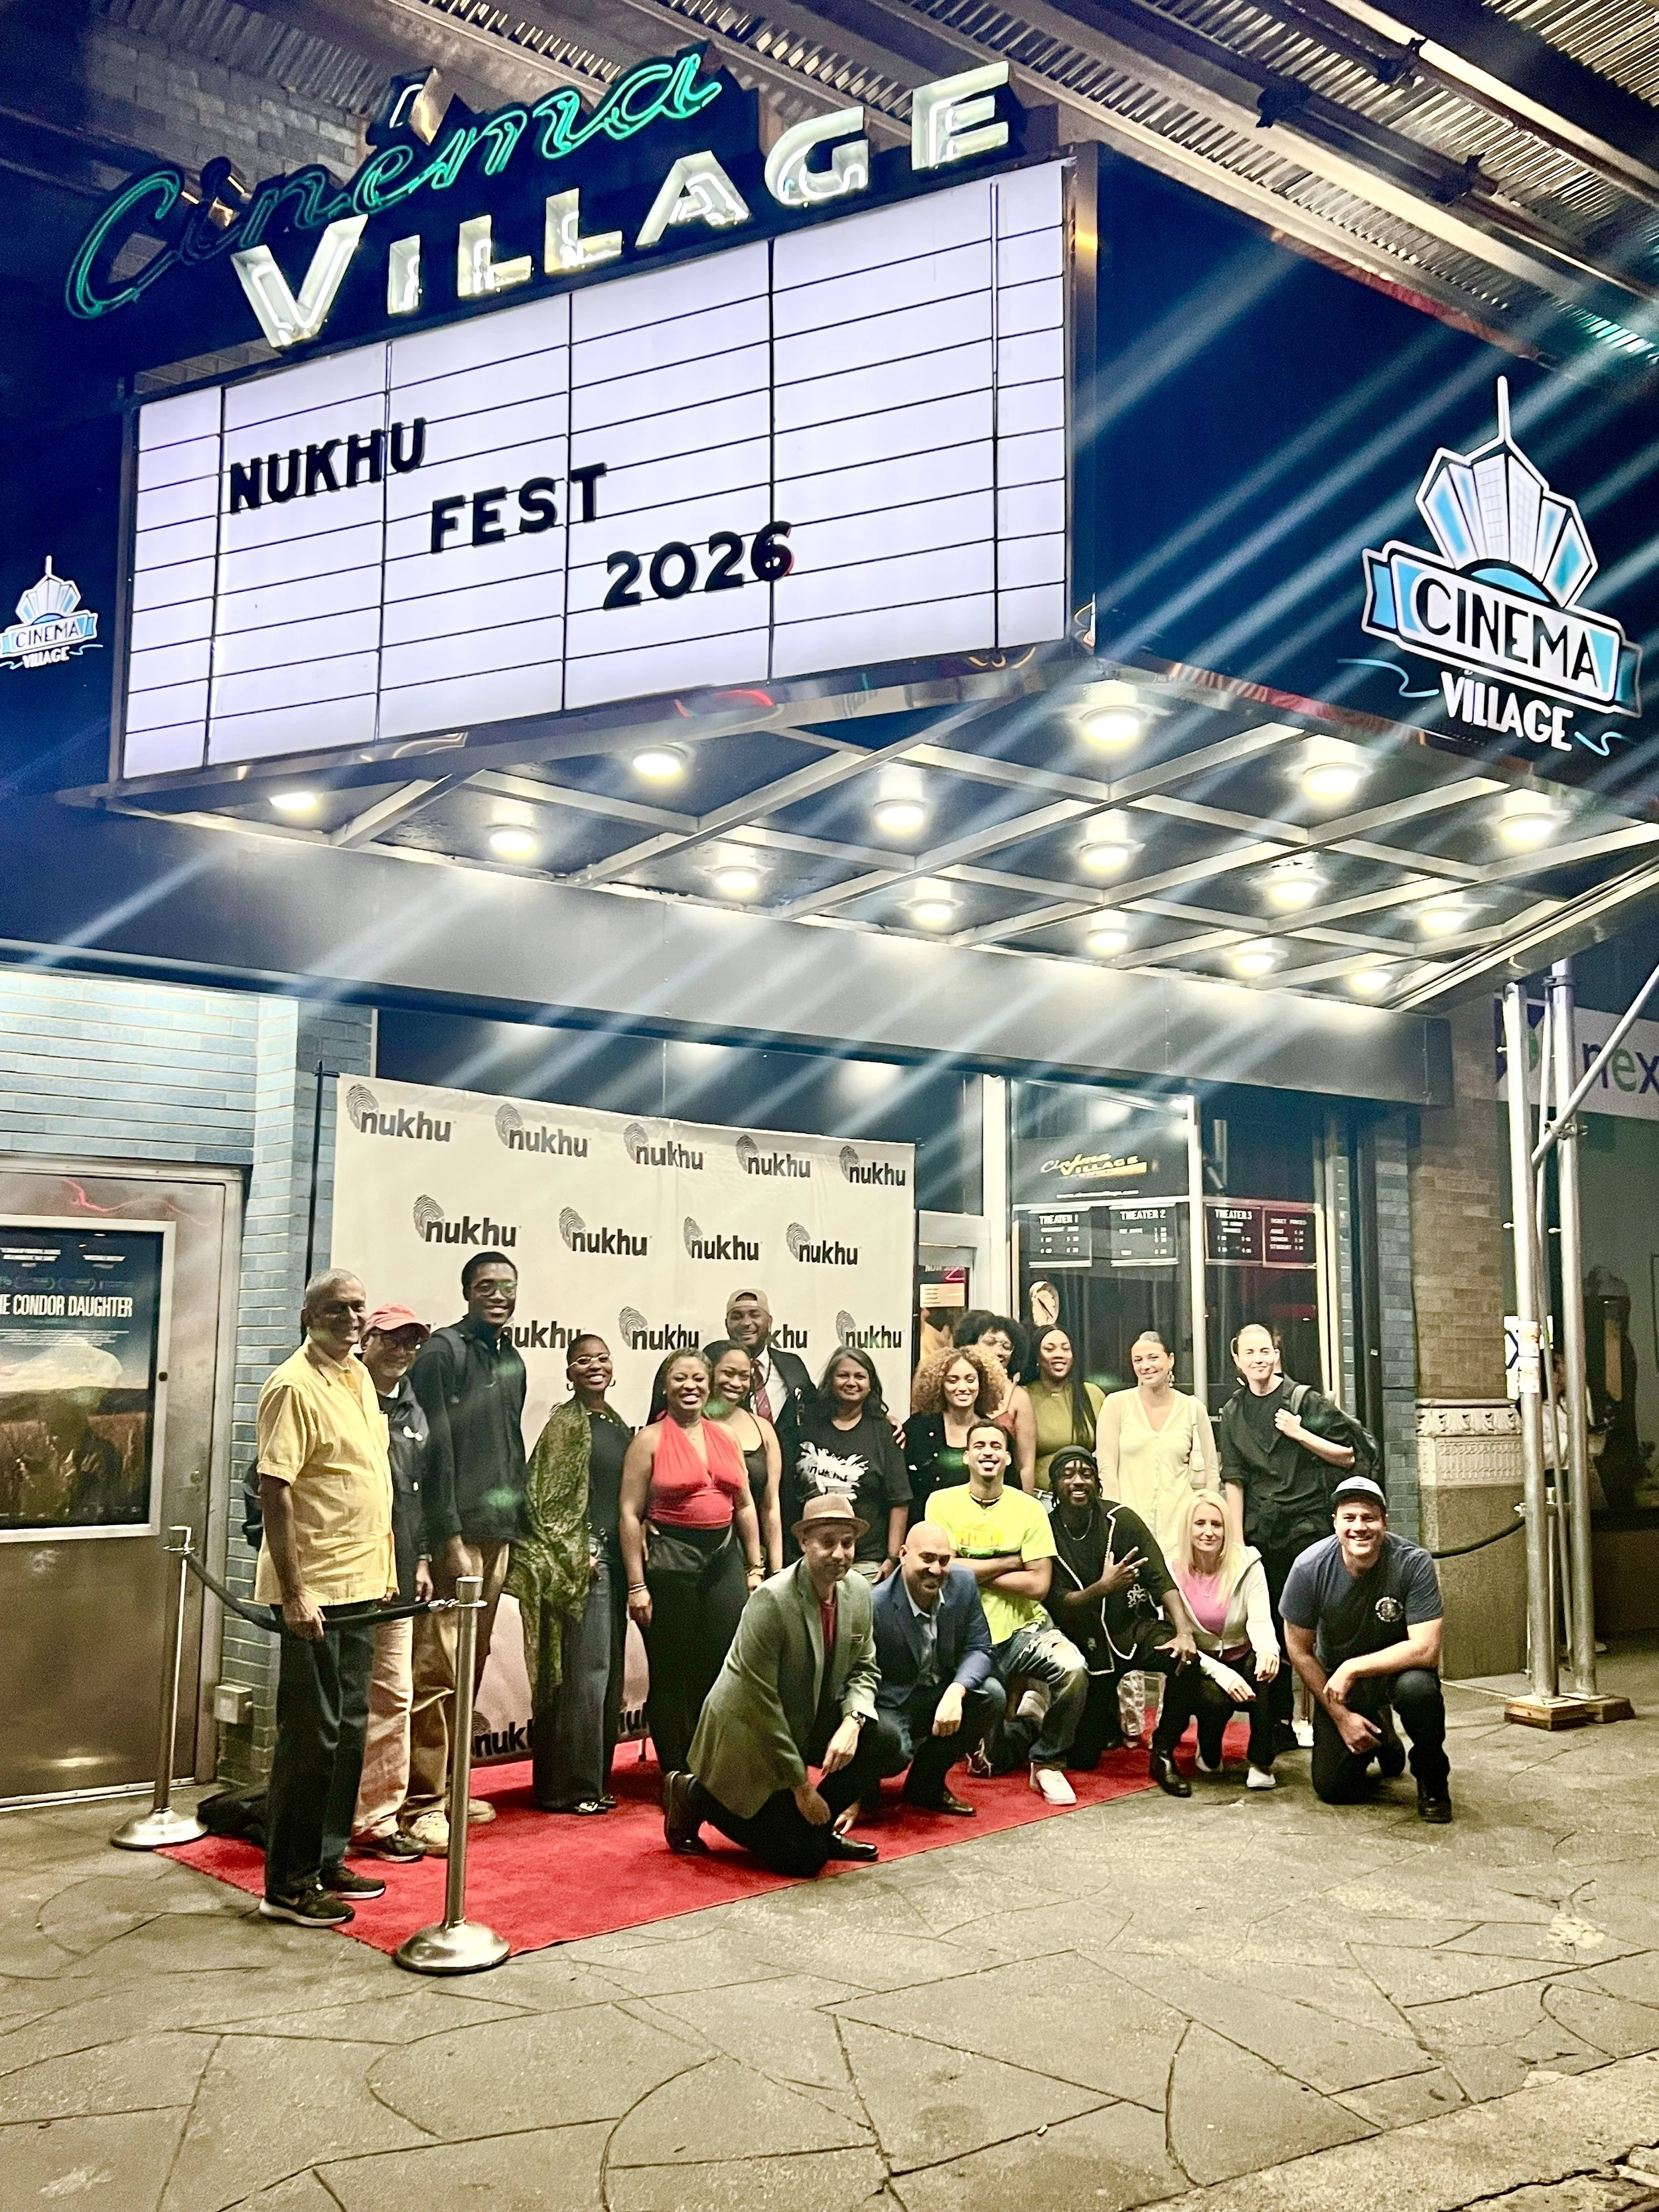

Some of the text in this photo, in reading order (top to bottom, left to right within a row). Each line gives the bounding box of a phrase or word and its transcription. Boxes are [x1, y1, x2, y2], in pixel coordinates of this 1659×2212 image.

[231, 60, 1009, 348] VILLAGE
[230, 417, 426, 514] NUKHU
[430, 462, 607, 553] FEST
[602, 520, 794, 610] 2026
[16, 619, 80, 648] CINEMA
[1415, 577, 1599, 688] CINEMA
[22, 646, 70, 668] VILLAGE
[1441, 670, 1574, 751] VILLAGE
[360, 1109, 452, 1142] nukhu
[509, 1127, 588, 1157] nukhu
[636, 1141, 703, 1170] nukhu
[748, 1153, 811, 1178] nukhu
[1060, 1155, 1139, 1176] VILLAGE
[849, 1162, 906, 1186] nukhu
[1039, 1214, 1073, 1224] THEATER
[1119, 1209, 1166, 1220] THEATER 2
[1214, 1209, 1247, 1219] THEATER
[425, 1217, 516, 1247] nukhu
[573, 1228, 647, 1256] nukhu
[691, 1235, 760, 1260] nukhu
[799, 1240, 858, 1265] nukhu
[13, 1294, 65, 1316] CONDOR
[68, 1295, 133, 1317] DAUGHTER
[632, 1324, 699, 1350] nukhu
[768, 1324, 808, 1349] khu
[845, 1325, 902, 1348] nukhu
